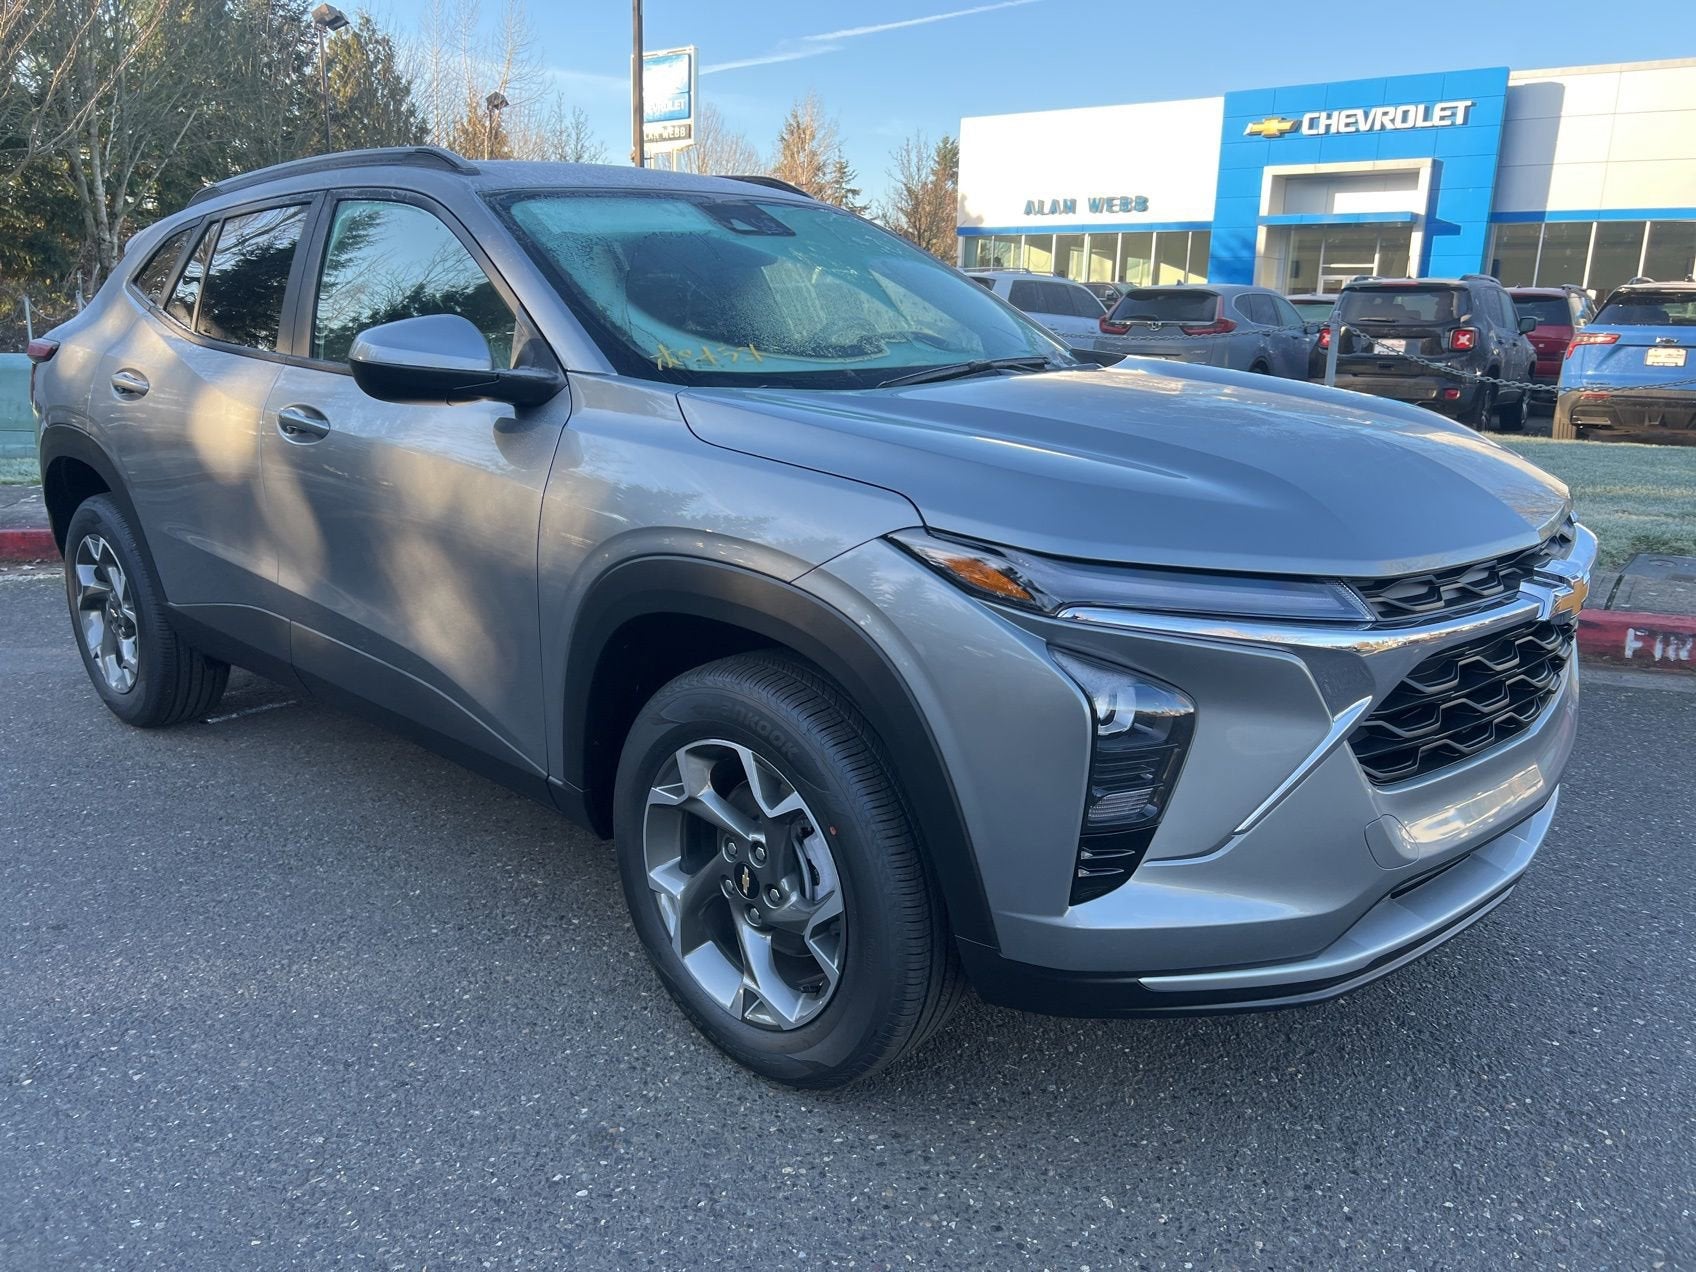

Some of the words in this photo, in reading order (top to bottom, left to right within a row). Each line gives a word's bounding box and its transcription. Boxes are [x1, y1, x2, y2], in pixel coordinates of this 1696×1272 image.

[1301, 100, 1474, 136] CHEVROLET
[662, 126, 686, 139] WEBB
[1024, 198, 1077, 216] ALAN
[1088, 195, 1149, 214] WEBB
